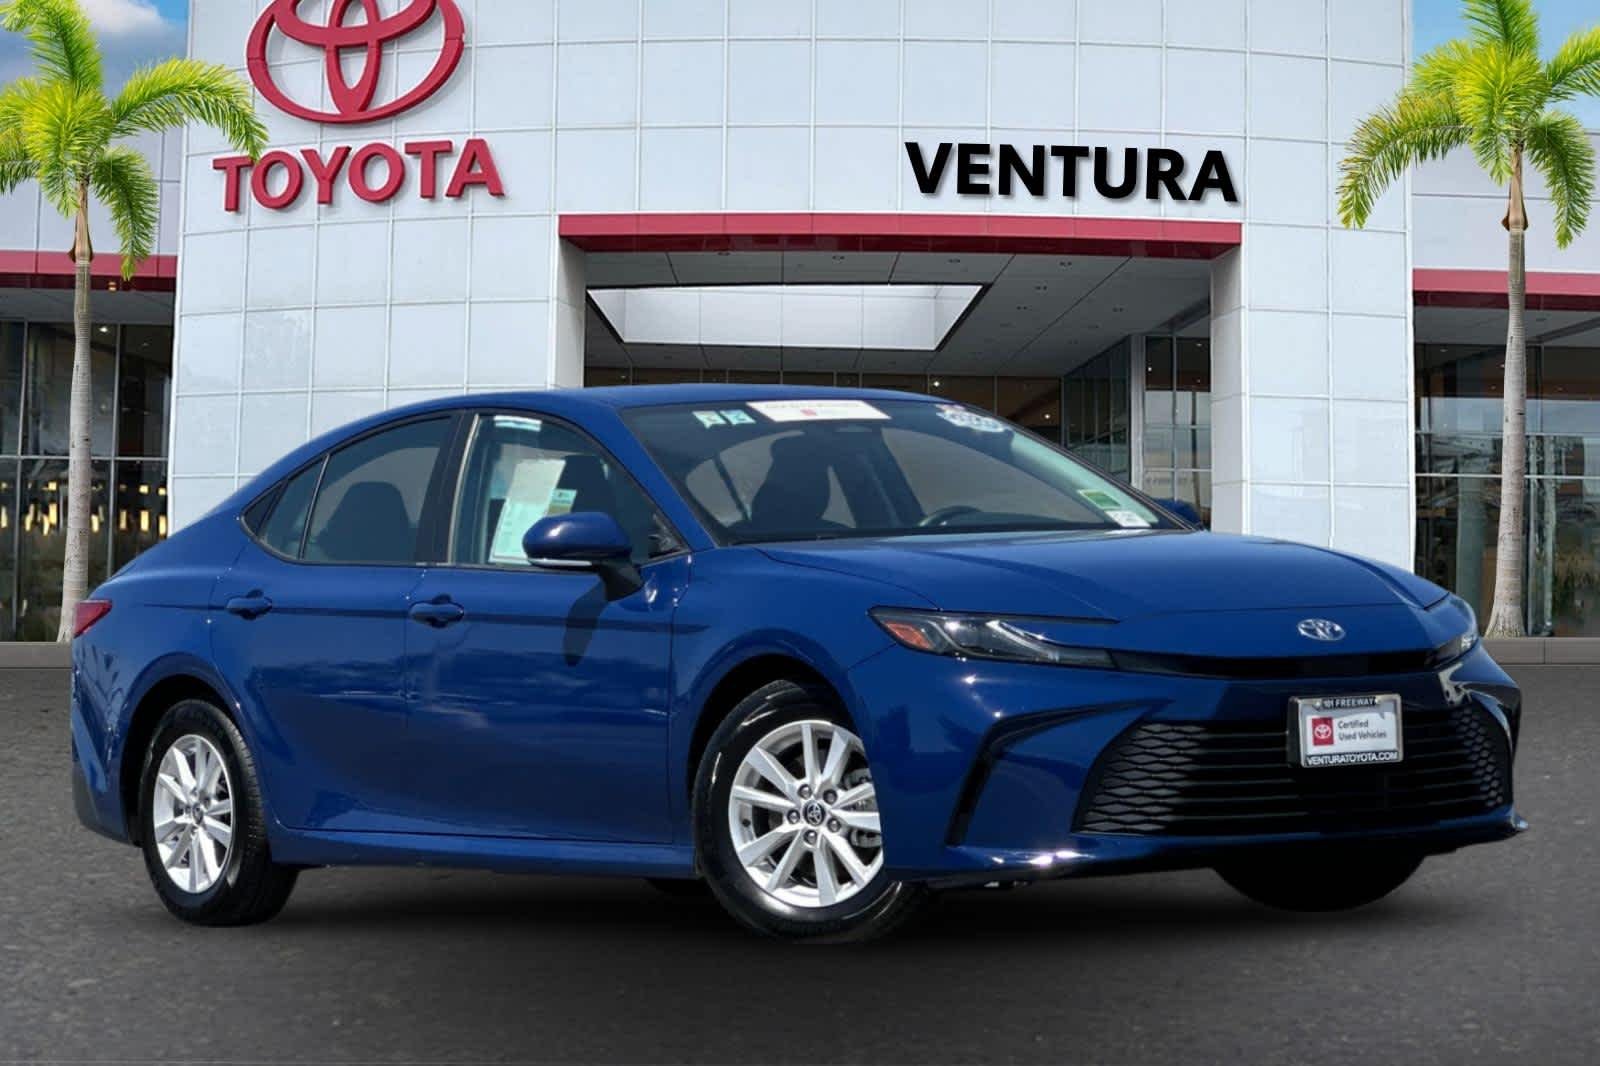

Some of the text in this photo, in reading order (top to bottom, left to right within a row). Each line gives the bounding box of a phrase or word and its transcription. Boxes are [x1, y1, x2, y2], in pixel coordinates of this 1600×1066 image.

[212, 138, 505, 212] TOYOTA
[904, 141, 1238, 202] VENTURA
[1335, 698, 1374, 707] FREEWAY
[1338, 720, 1368, 729] Certified
[1339, 730, 1387, 740] Used Vehicles
[1307, 751, 1398, 765] VENTURATOYOTA.COM
